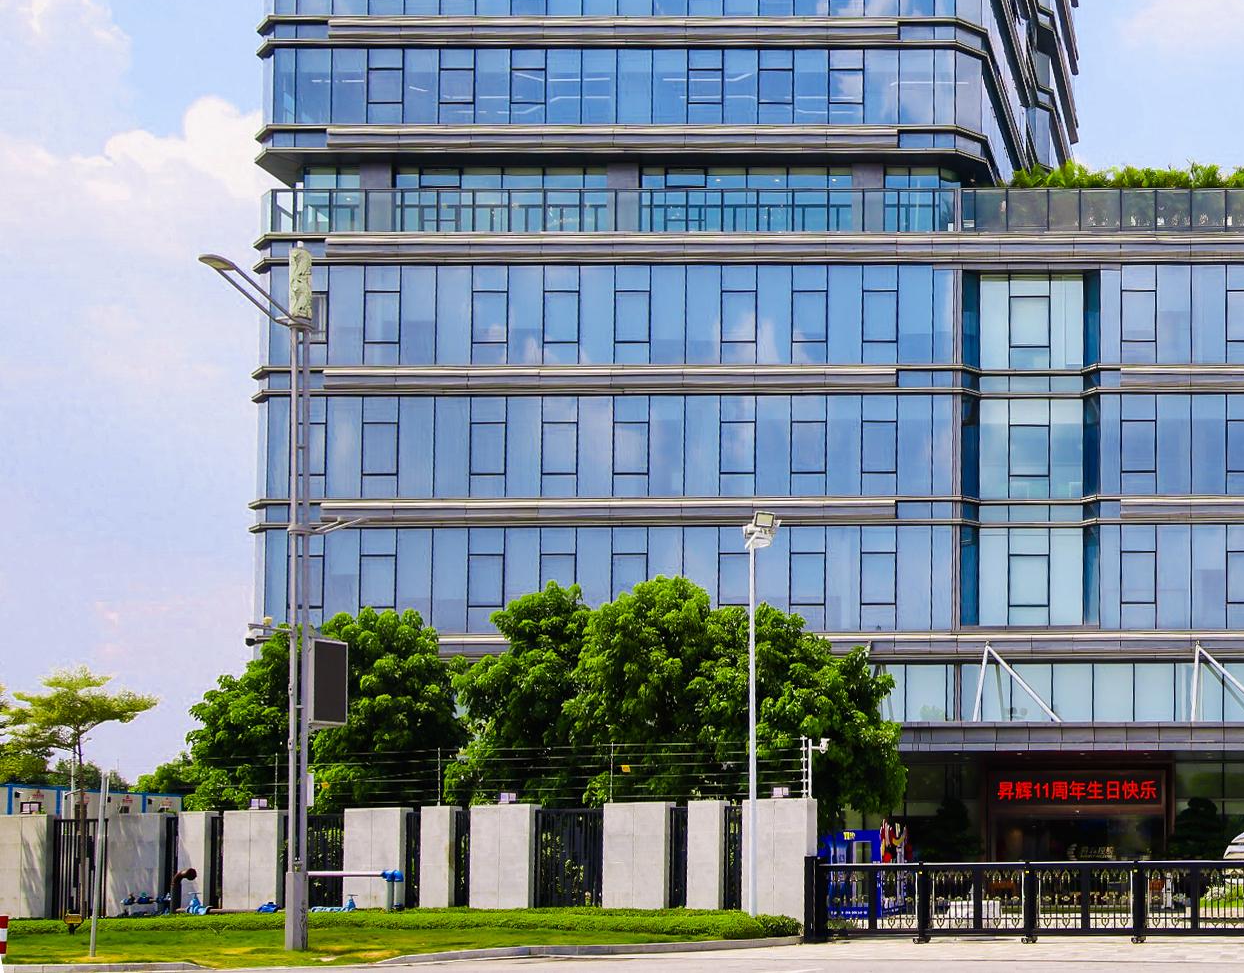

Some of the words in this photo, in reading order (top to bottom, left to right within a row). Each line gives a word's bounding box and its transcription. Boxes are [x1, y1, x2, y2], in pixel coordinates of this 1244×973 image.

[997, 780, 1157, 800] 昇辉11周年生日快乐
